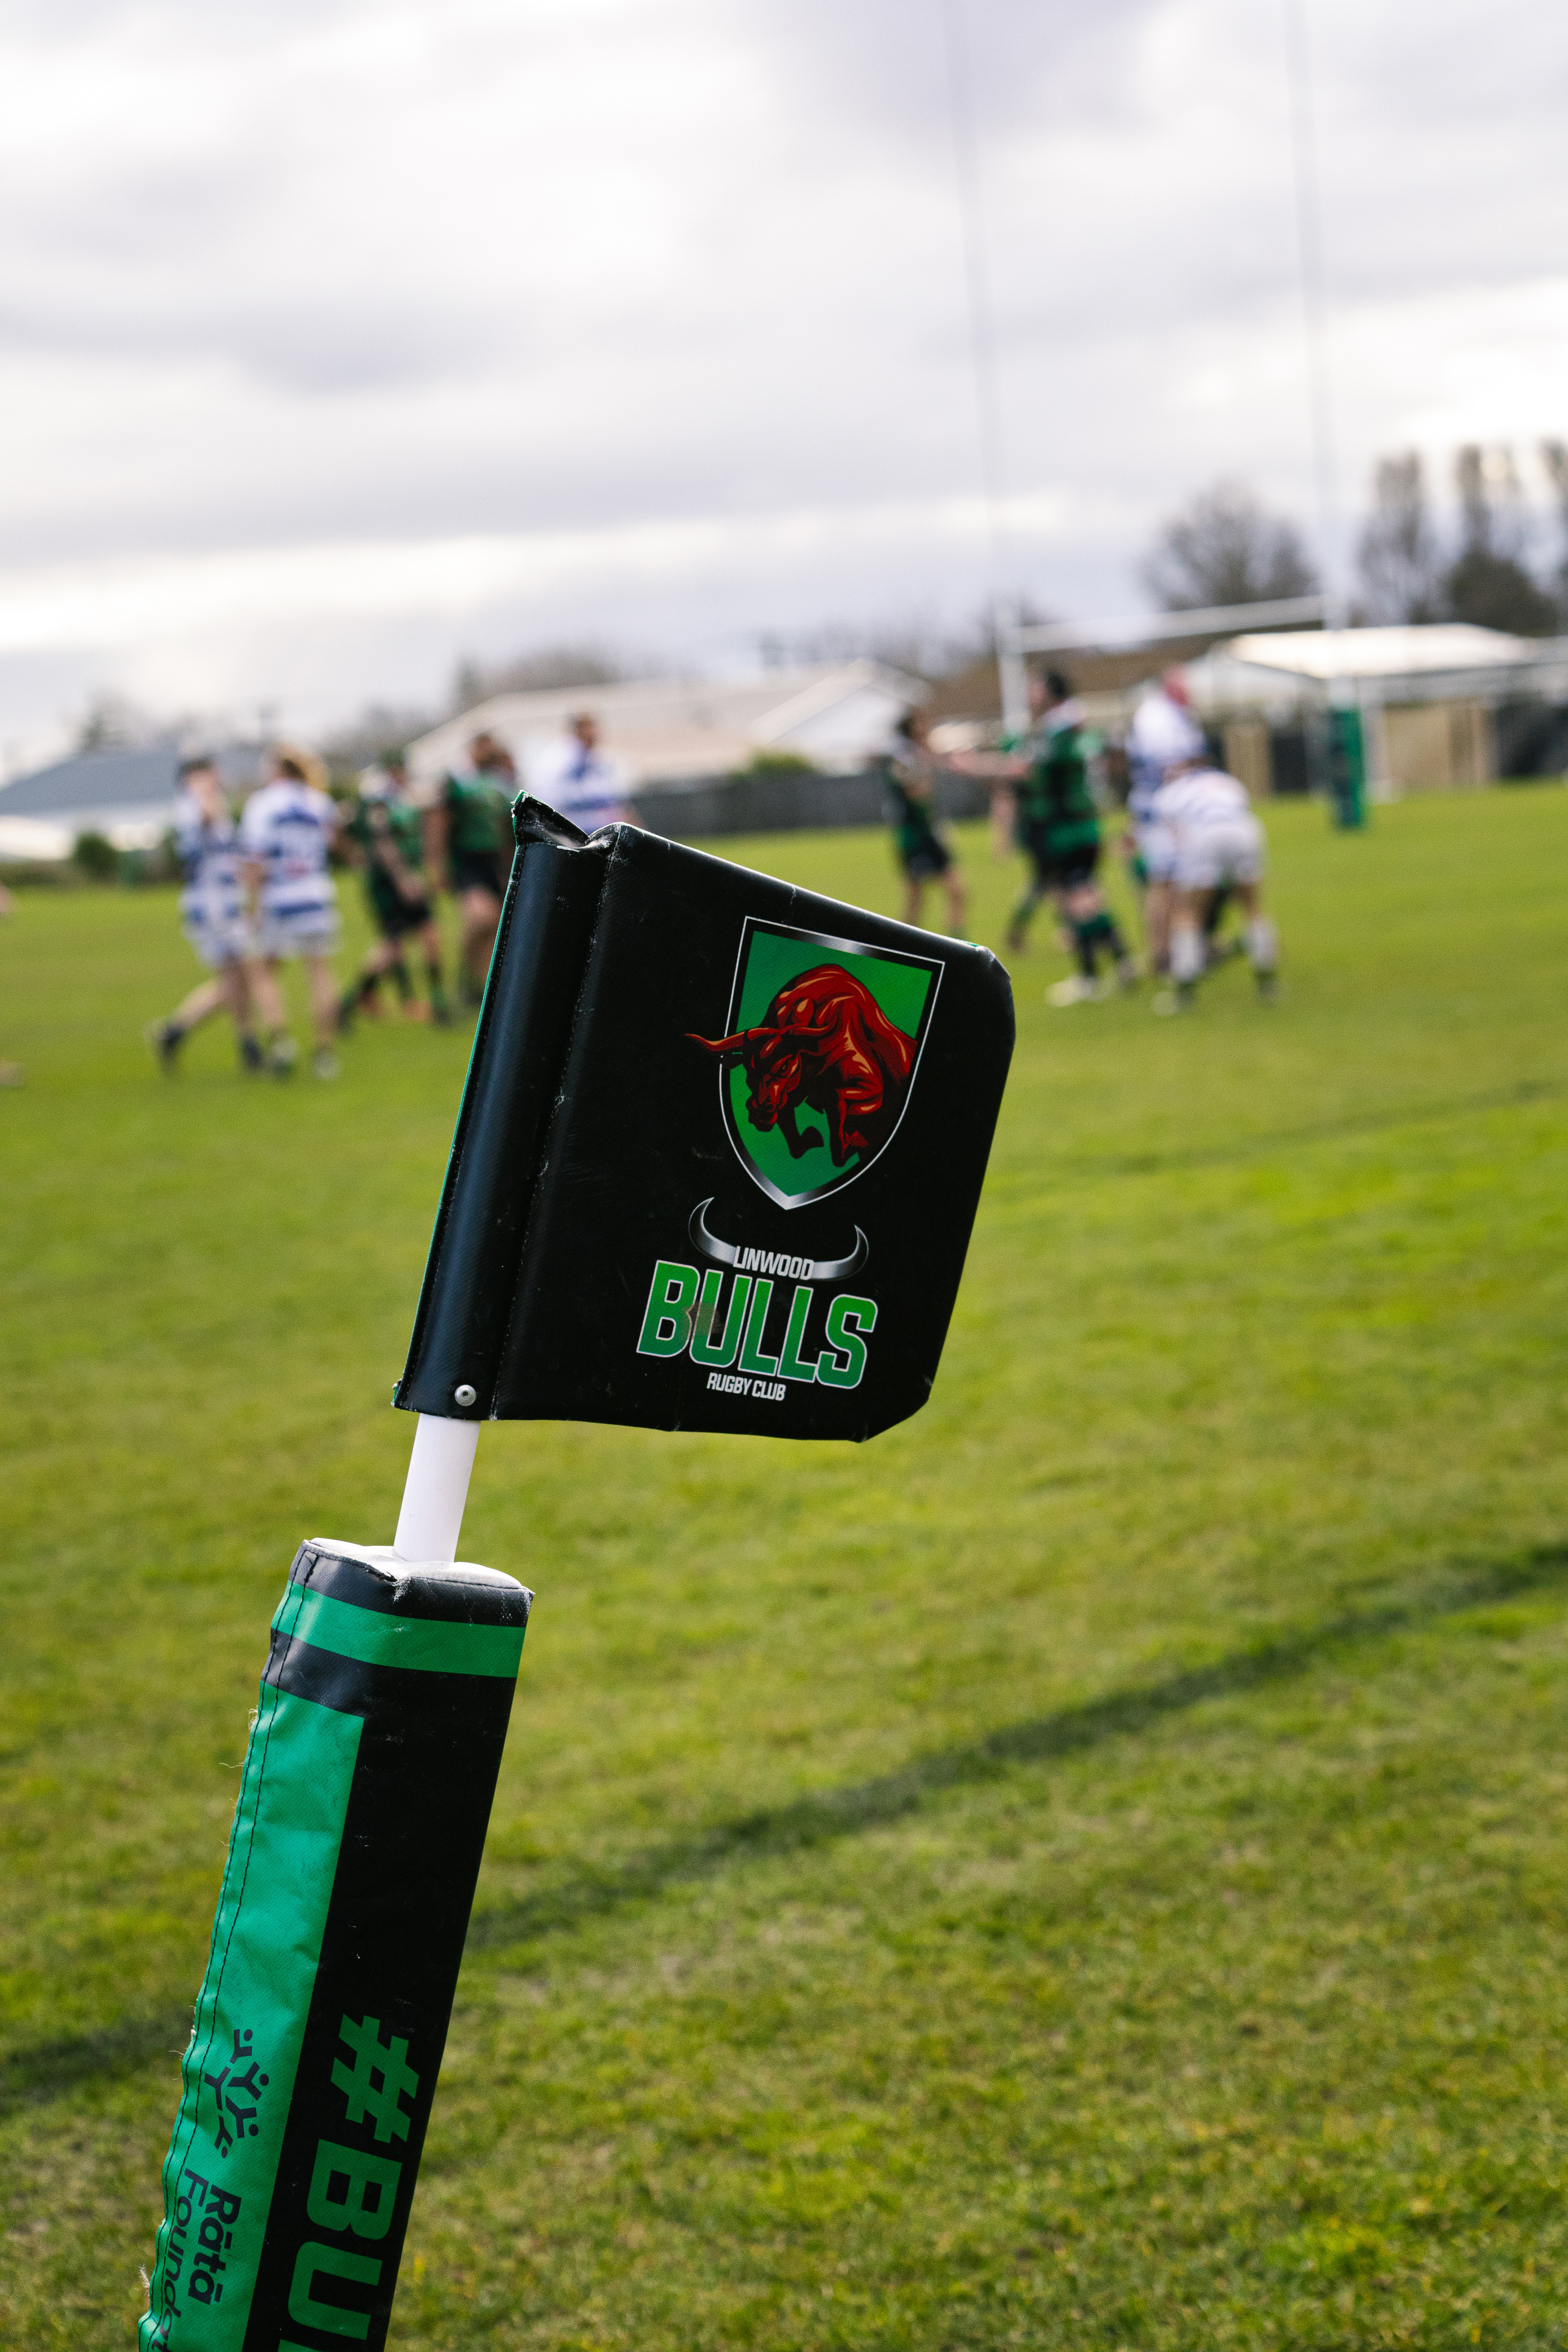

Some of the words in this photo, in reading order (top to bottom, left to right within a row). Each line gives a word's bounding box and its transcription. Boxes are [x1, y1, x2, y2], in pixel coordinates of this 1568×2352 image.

[636, 1260, 878, 1389] BULLS
[733, 1245, 815, 1281] LINWOOD
[706, 1372, 753, 1395] RUGBY
[752, 1379, 786, 1401] CLUB
[187, 2182, 242, 2305] Rātā
[278, 2013, 419, 2352] #BU
